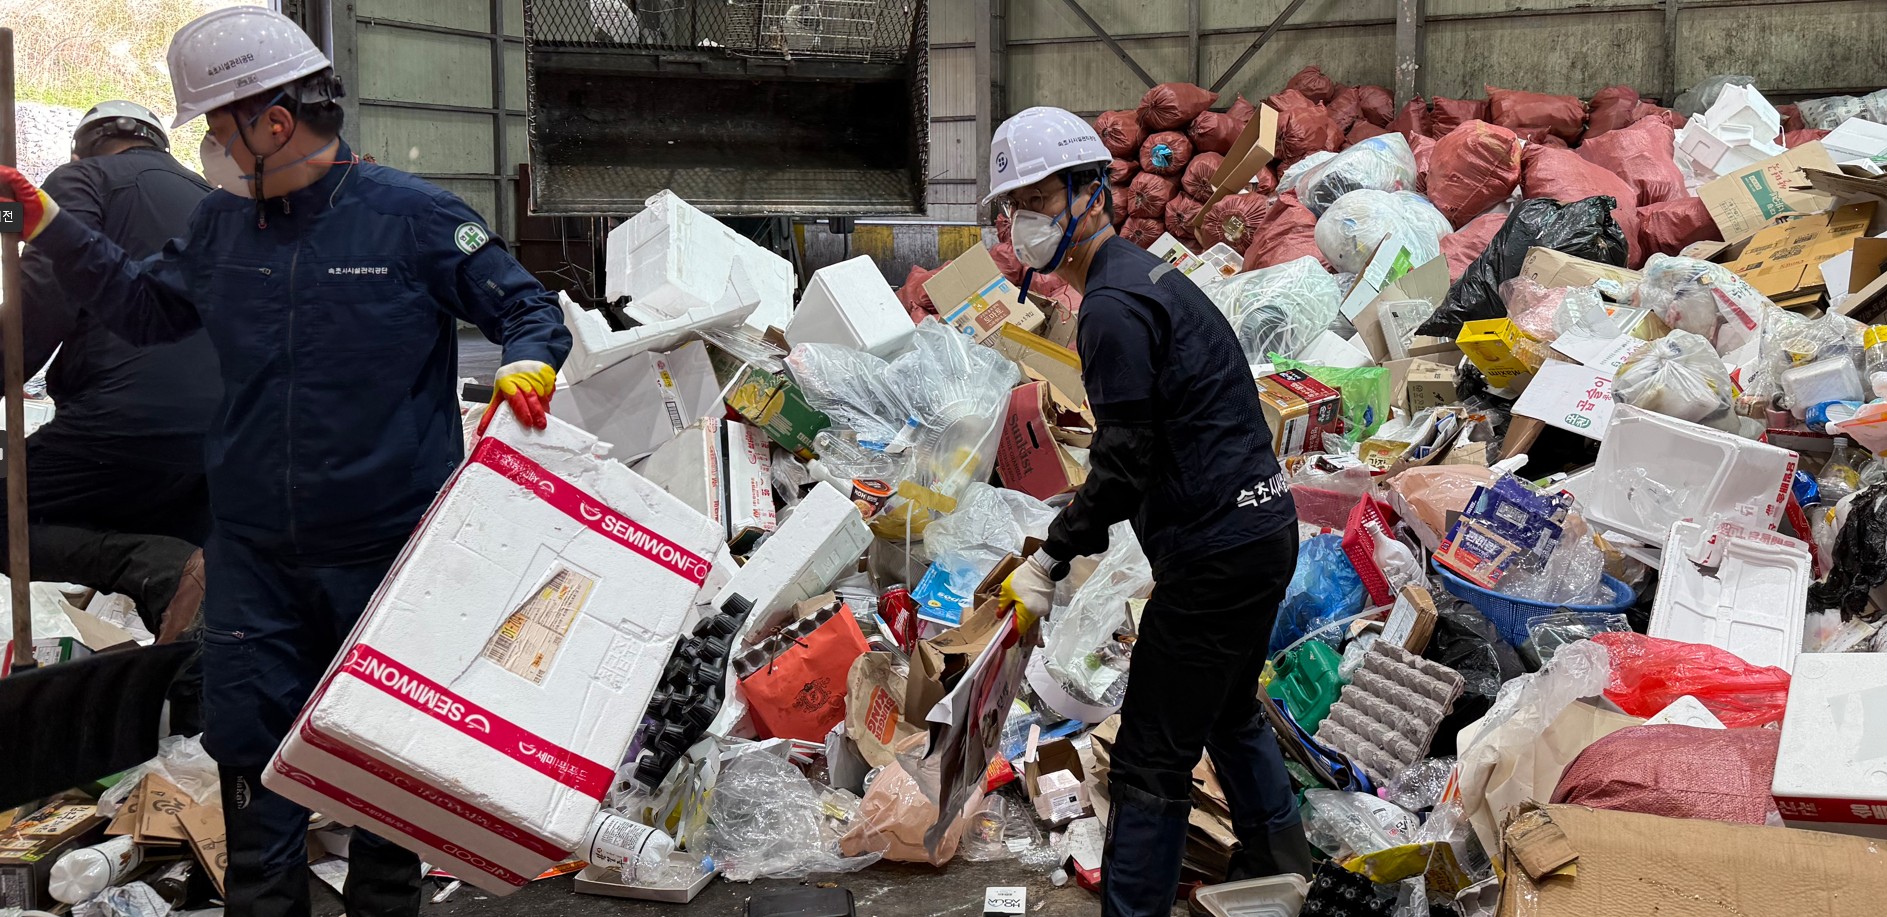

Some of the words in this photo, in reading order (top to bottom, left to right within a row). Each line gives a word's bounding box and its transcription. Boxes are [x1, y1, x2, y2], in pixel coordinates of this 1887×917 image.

[1488, 369, 1521, 378] Maxim
[1576, 376, 1612, 411] 곱슬이
[1008, 413, 1034, 477] Sunkist
[867, 687, 889, 735] KING
[875, 696, 896, 741] BURGER
